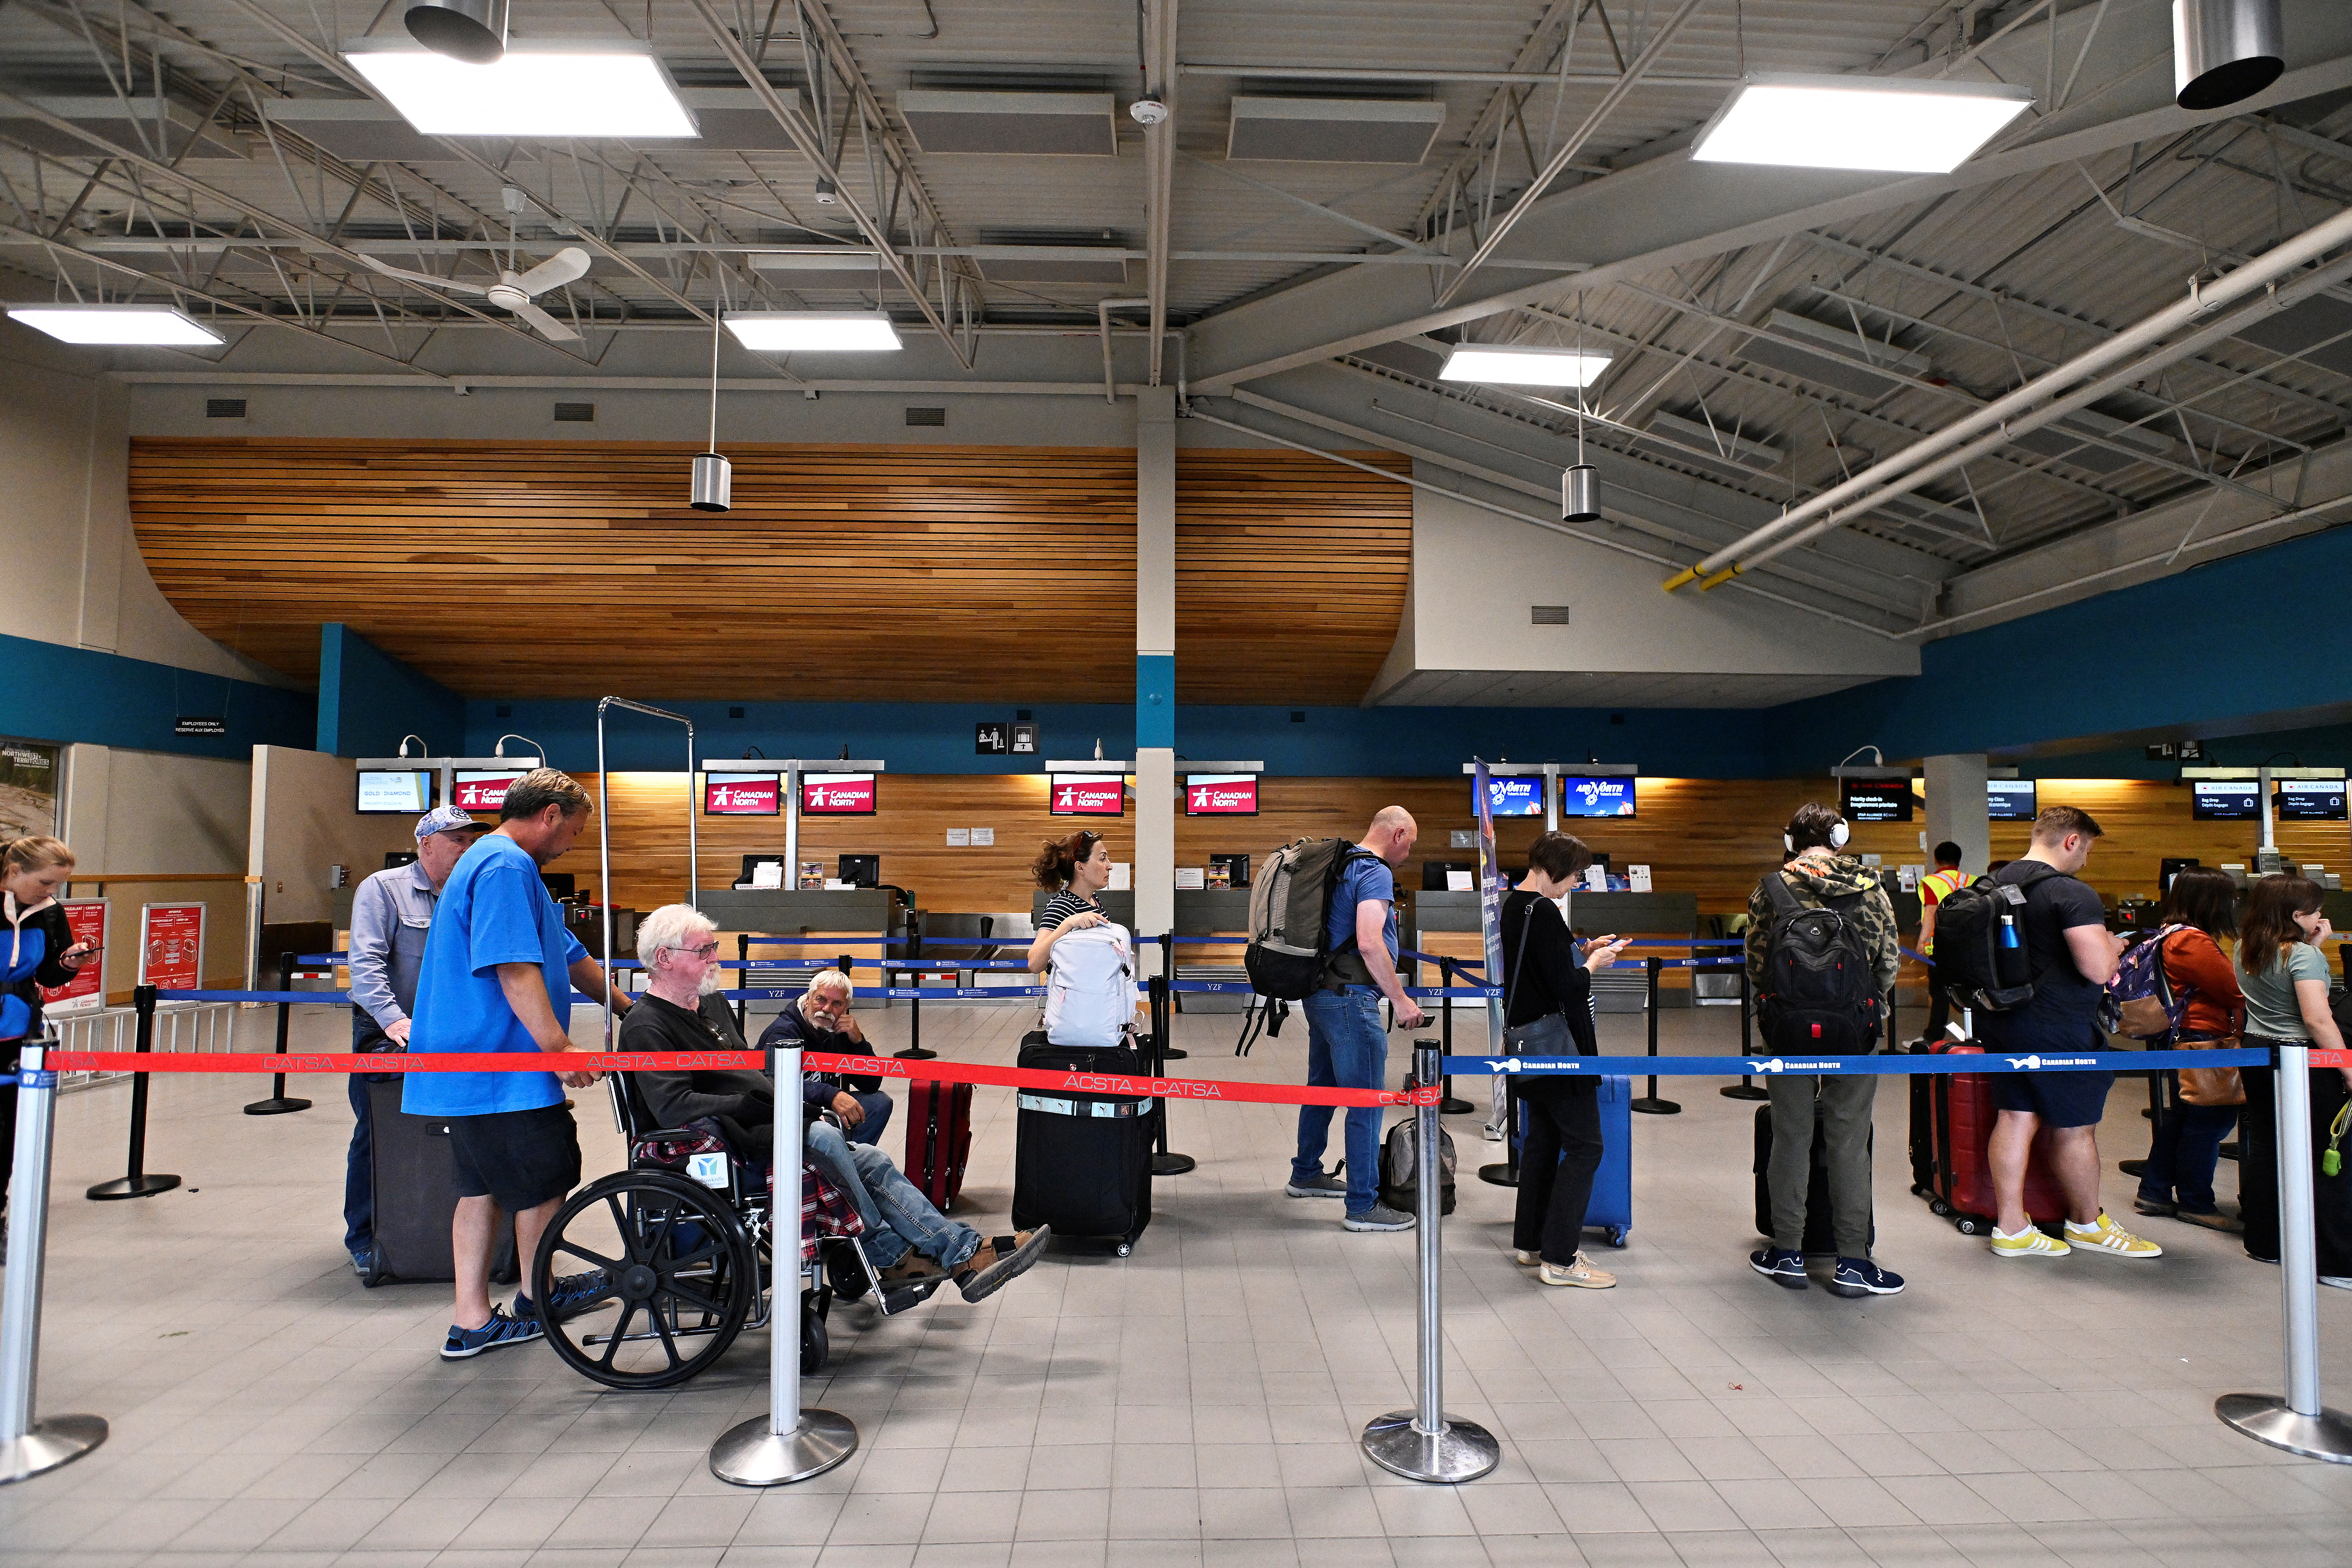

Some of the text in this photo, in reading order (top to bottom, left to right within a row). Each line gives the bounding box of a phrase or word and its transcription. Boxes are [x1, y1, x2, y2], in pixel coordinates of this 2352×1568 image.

[2, 750, 38, 759] NORTHWEST
[13, 756, 49, 765] TERRITORIES
[1497, 781, 1531, 795] NORTH
[1576, 781, 1624, 795] AIR NORTH
[734, 790, 773, 799] CANADIAN
[830, 790, 870, 799] CANADIAN
[1079, 791, 1118, 799] CANADIAN
[1213, 791, 1252, 799] CANADIAN
[1077, 798, 1104, 806] NORTH
[263, 1057, 424, 1070] CATSA ACSTA
[586, 1054, 747, 1068] ACSTA CATSA
[836, 1058, 906, 1074] ACSTA
[1063, 1074, 1221, 1097] ACSTA CATSA
